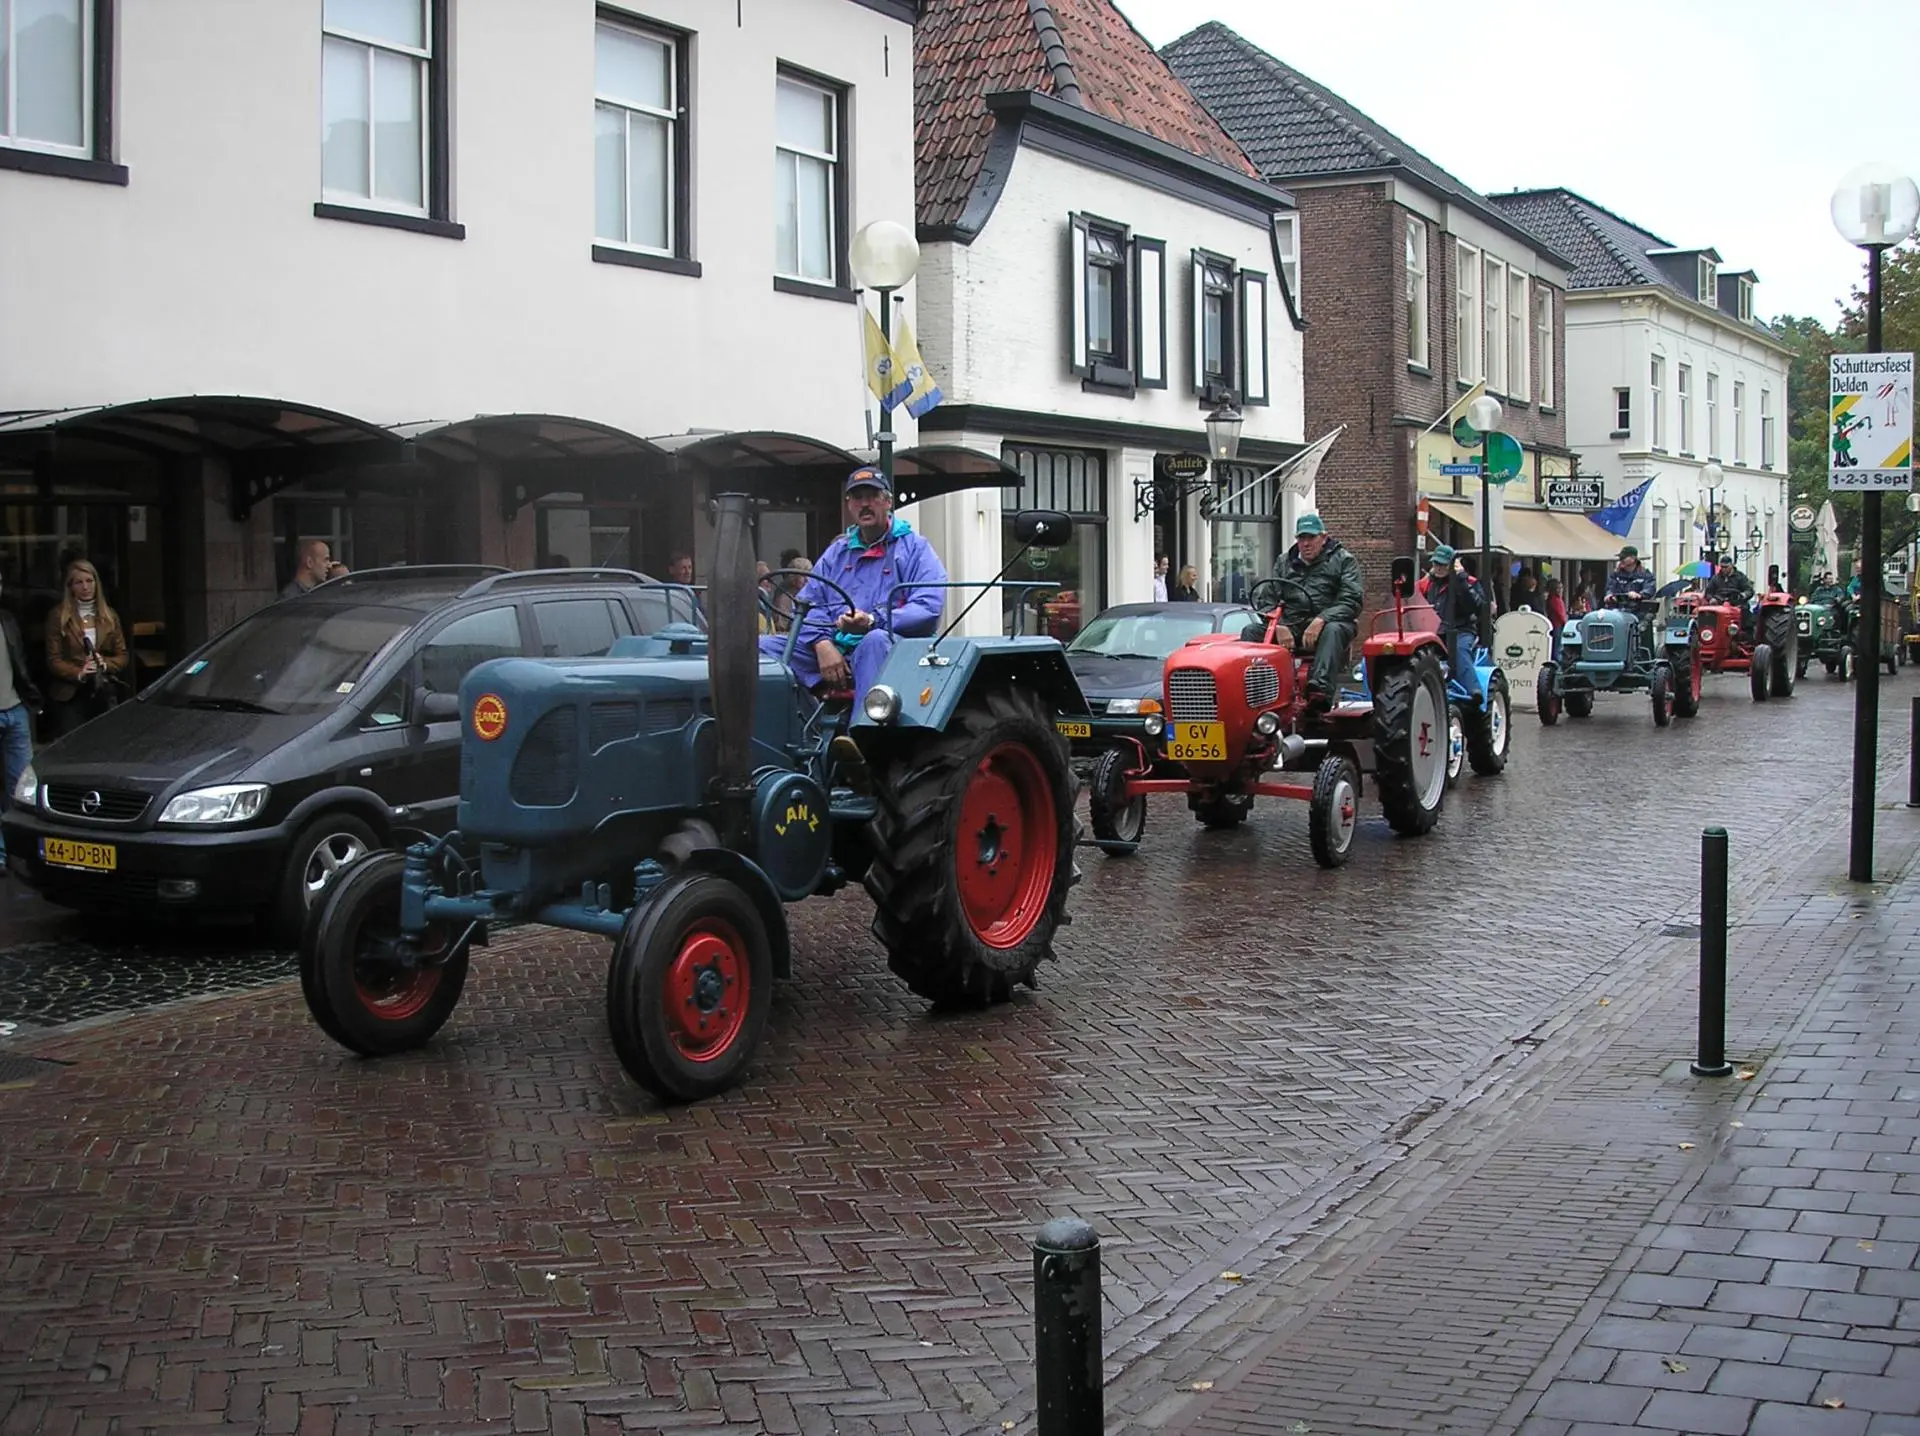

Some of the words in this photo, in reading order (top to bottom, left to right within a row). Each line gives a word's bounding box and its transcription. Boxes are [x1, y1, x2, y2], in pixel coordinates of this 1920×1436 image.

[1832, 357, 1911, 374] Schuttersfeest
[1833, 377, 1868, 392] Delden
[1168, 457, 1203, 471] Antiek
[1555, 483, 1592, 491] OPTIEK
[1833, 474, 1868, 484] 1-2-3
[1874, 474, 1908, 486] Sept
[1554, 497, 1594, 505] AARSEN
[1189, 724, 1208, 739] GV
[1174, 743, 1220, 758] 86-56
[775, 804, 819, 836] LANZ
[49, 842, 111, 865] 44-JD-BN
